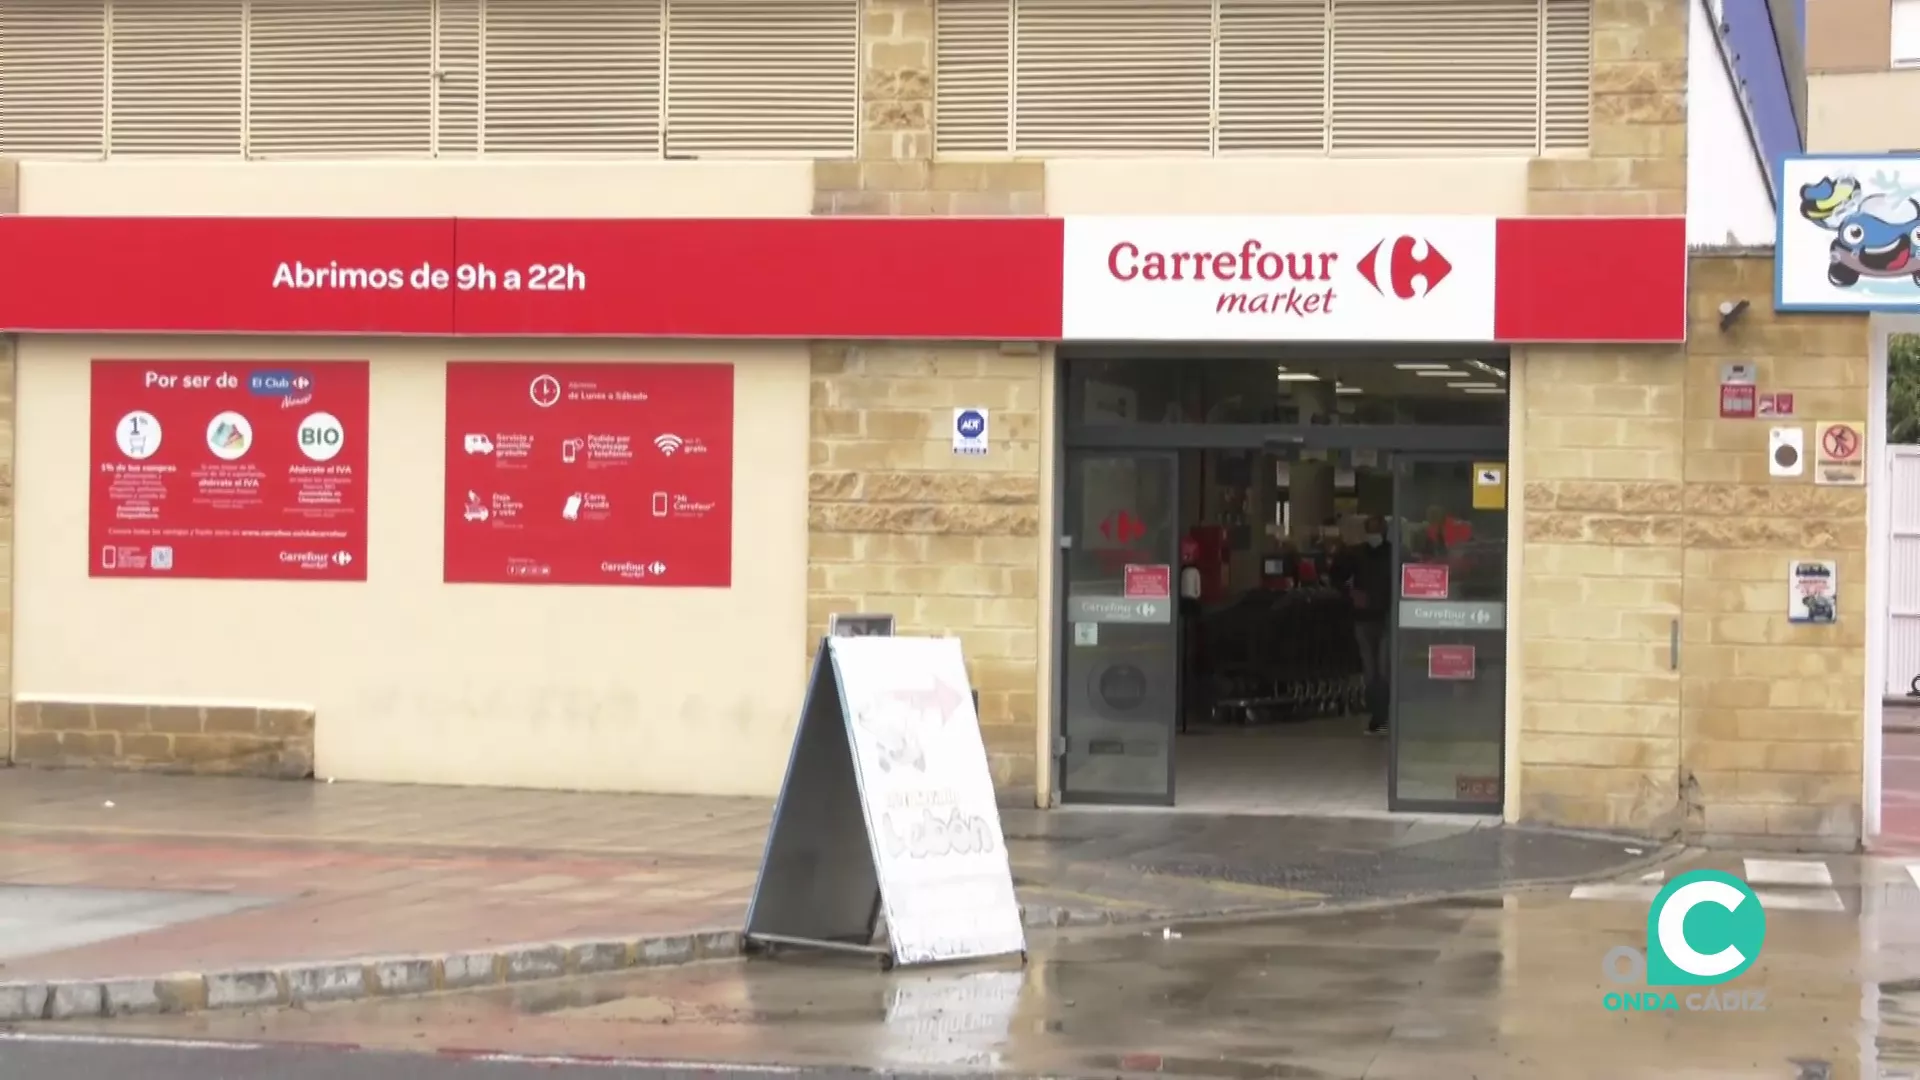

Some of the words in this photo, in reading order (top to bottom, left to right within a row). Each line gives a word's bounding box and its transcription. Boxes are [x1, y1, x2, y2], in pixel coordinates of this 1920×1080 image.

[1107, 239, 1338, 281] Carrefour
[272, 260, 404, 289] Abrimos
[410, 262, 449, 289] de
[456, 263, 497, 291] 9h
[503, 269, 521, 291] a
[527, 263, 586, 292] 22h
[1215, 286, 1337, 317] market
[145, 371, 178, 388] Por
[182, 374, 211, 388] ser
[216, 371, 238, 388] de
[252, 377, 262, 388] El
[265, 376, 289, 388] Club
[581, 390, 606, 400] Lunes
[301, 427, 340, 446] BIO
[279, 551, 328, 562] Carrefour
[601, 561, 645, 572] Carrefour
[1414, 608, 1465, 620] Carrefour
